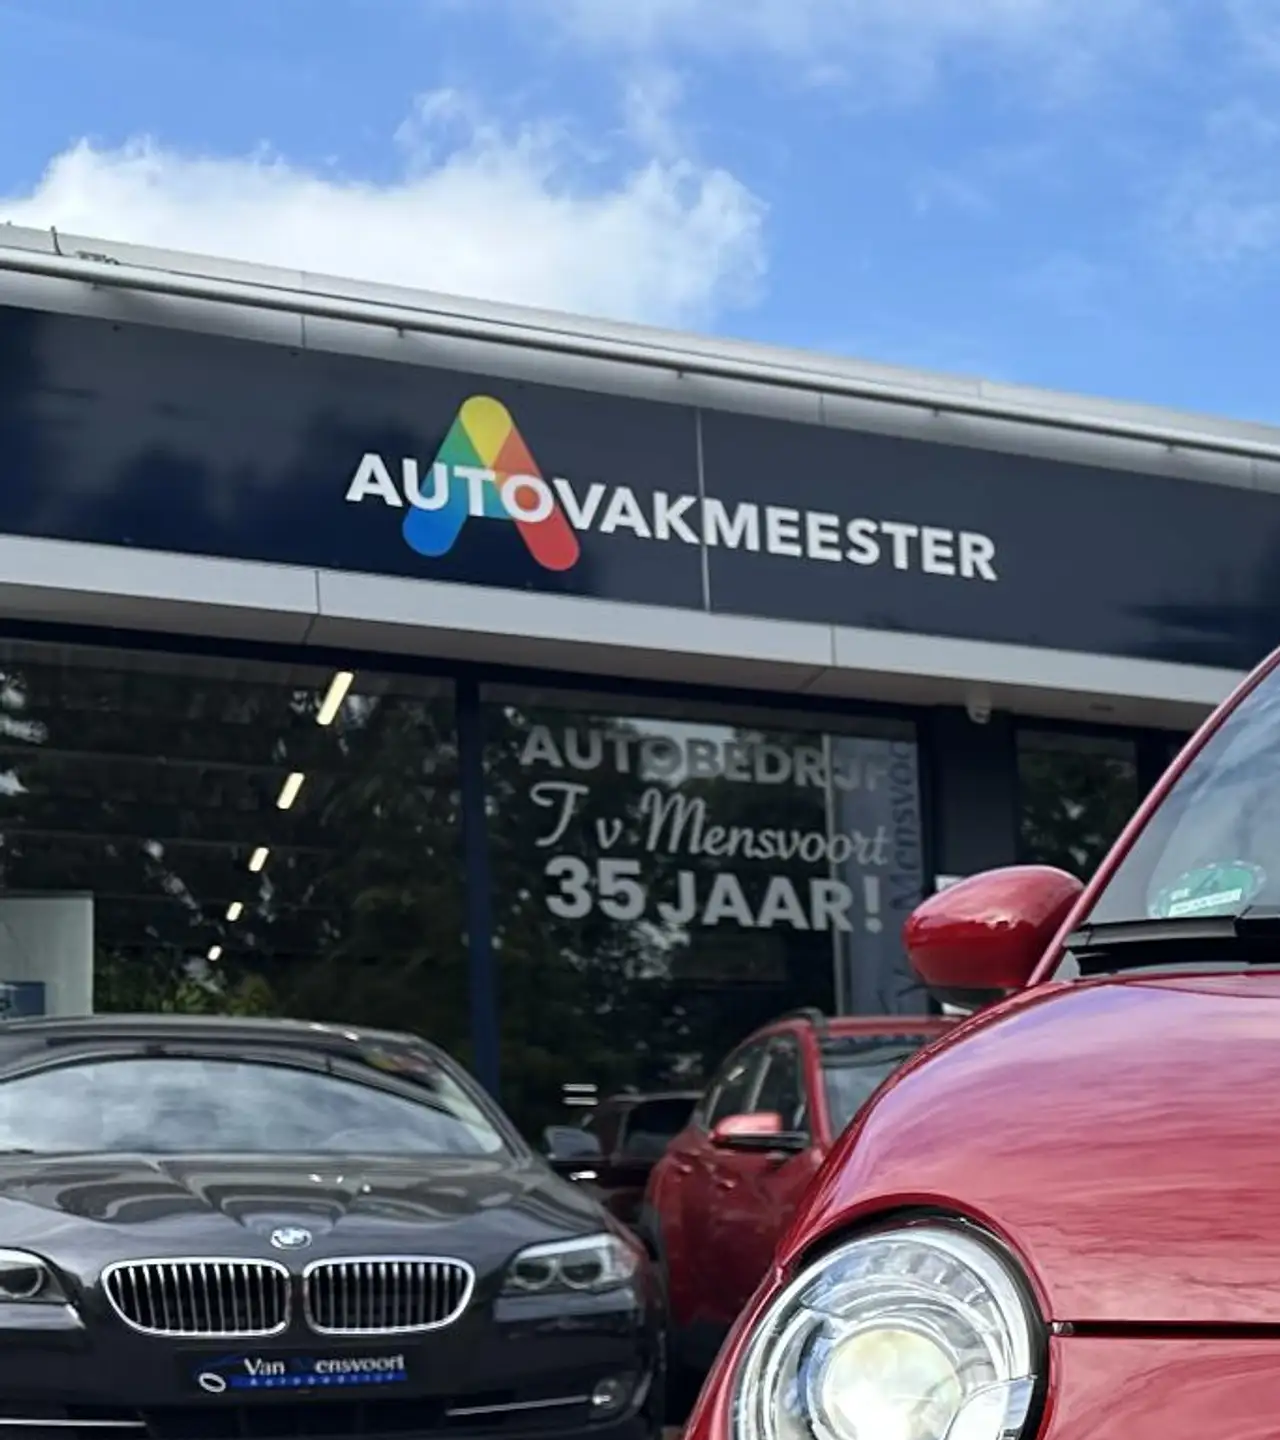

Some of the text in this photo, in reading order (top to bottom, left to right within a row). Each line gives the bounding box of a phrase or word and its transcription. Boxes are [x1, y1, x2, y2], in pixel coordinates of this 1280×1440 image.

[346, 452, 998, 581] AUTOVAKMEESTER
[639, 787, 889, 865] Mensvoort
[544, 855, 884, 934] 35 JAAR!
[244, 1353, 405, 1377] Van ensvoort
